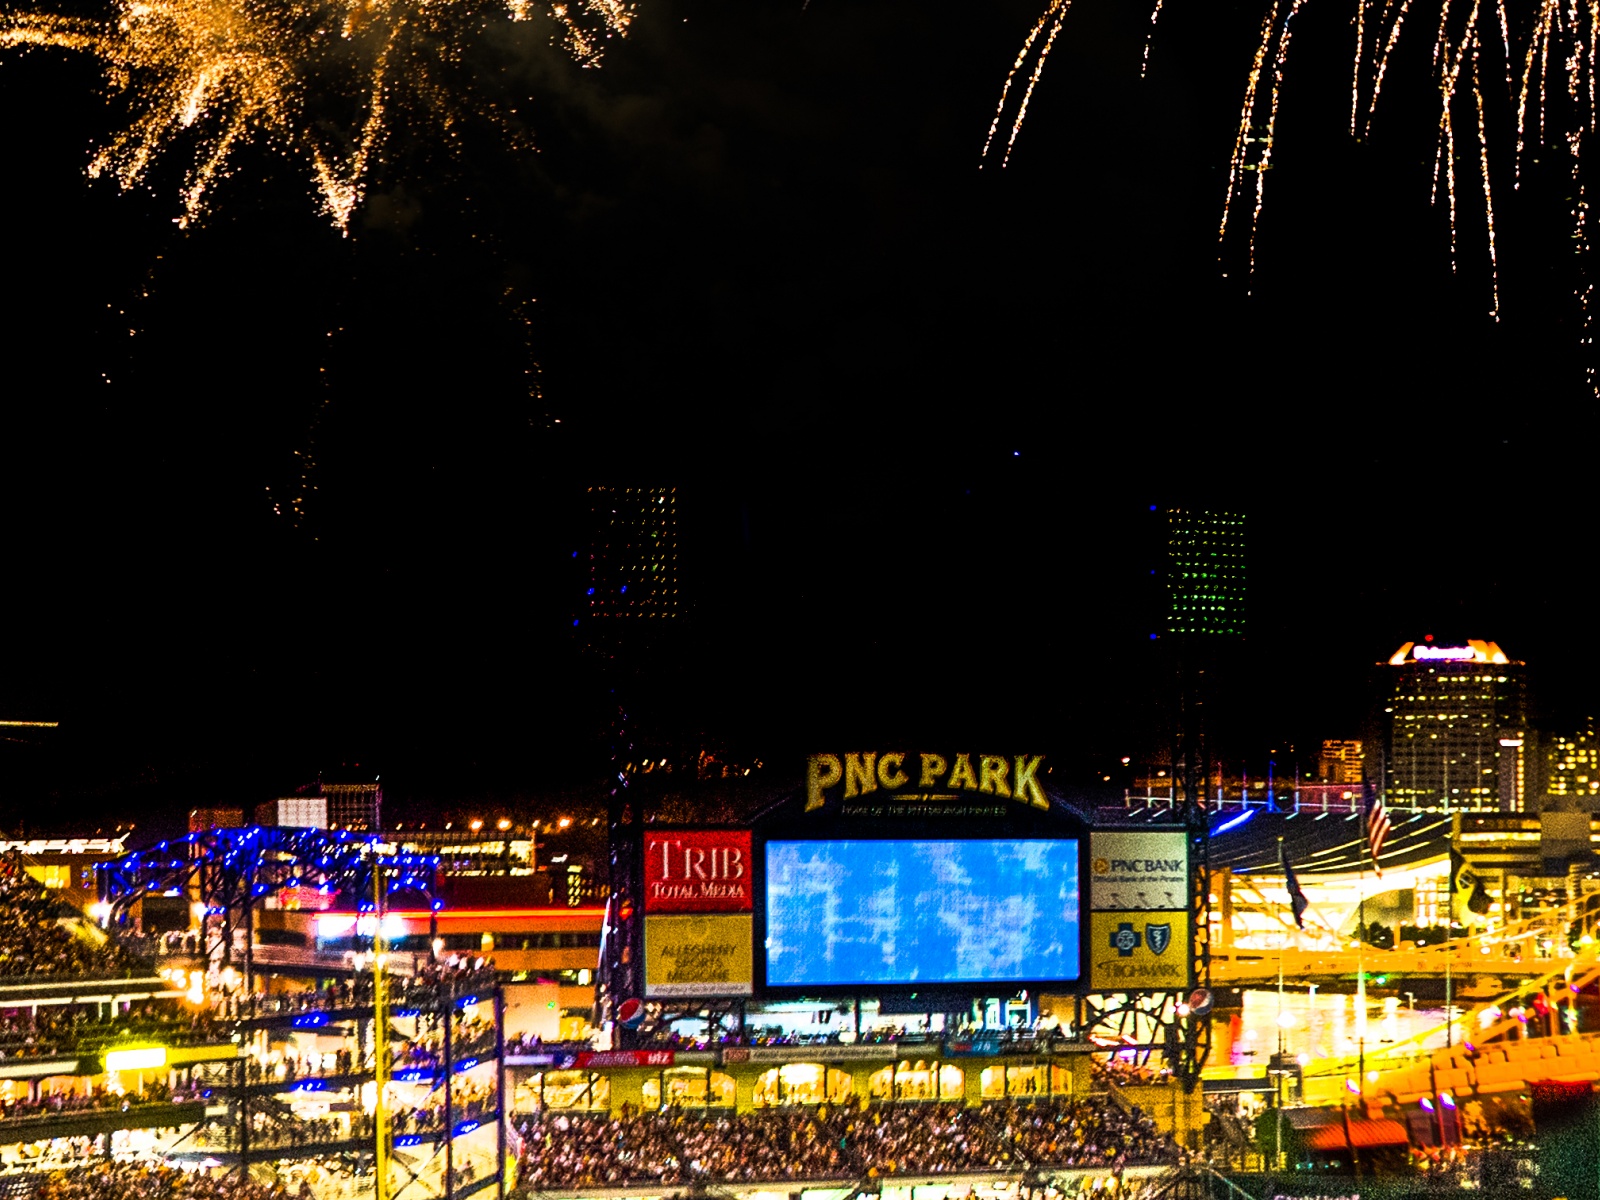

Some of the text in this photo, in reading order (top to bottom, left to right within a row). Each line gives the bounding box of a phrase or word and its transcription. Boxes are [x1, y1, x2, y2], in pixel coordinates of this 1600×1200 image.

[804, 752, 1050, 812] PNC PARK
[650, 839, 744, 880] TRIB
[1111, 858, 1184, 873] PNC BANK
[651, 881, 746, 898] TOTAL MEDIA
